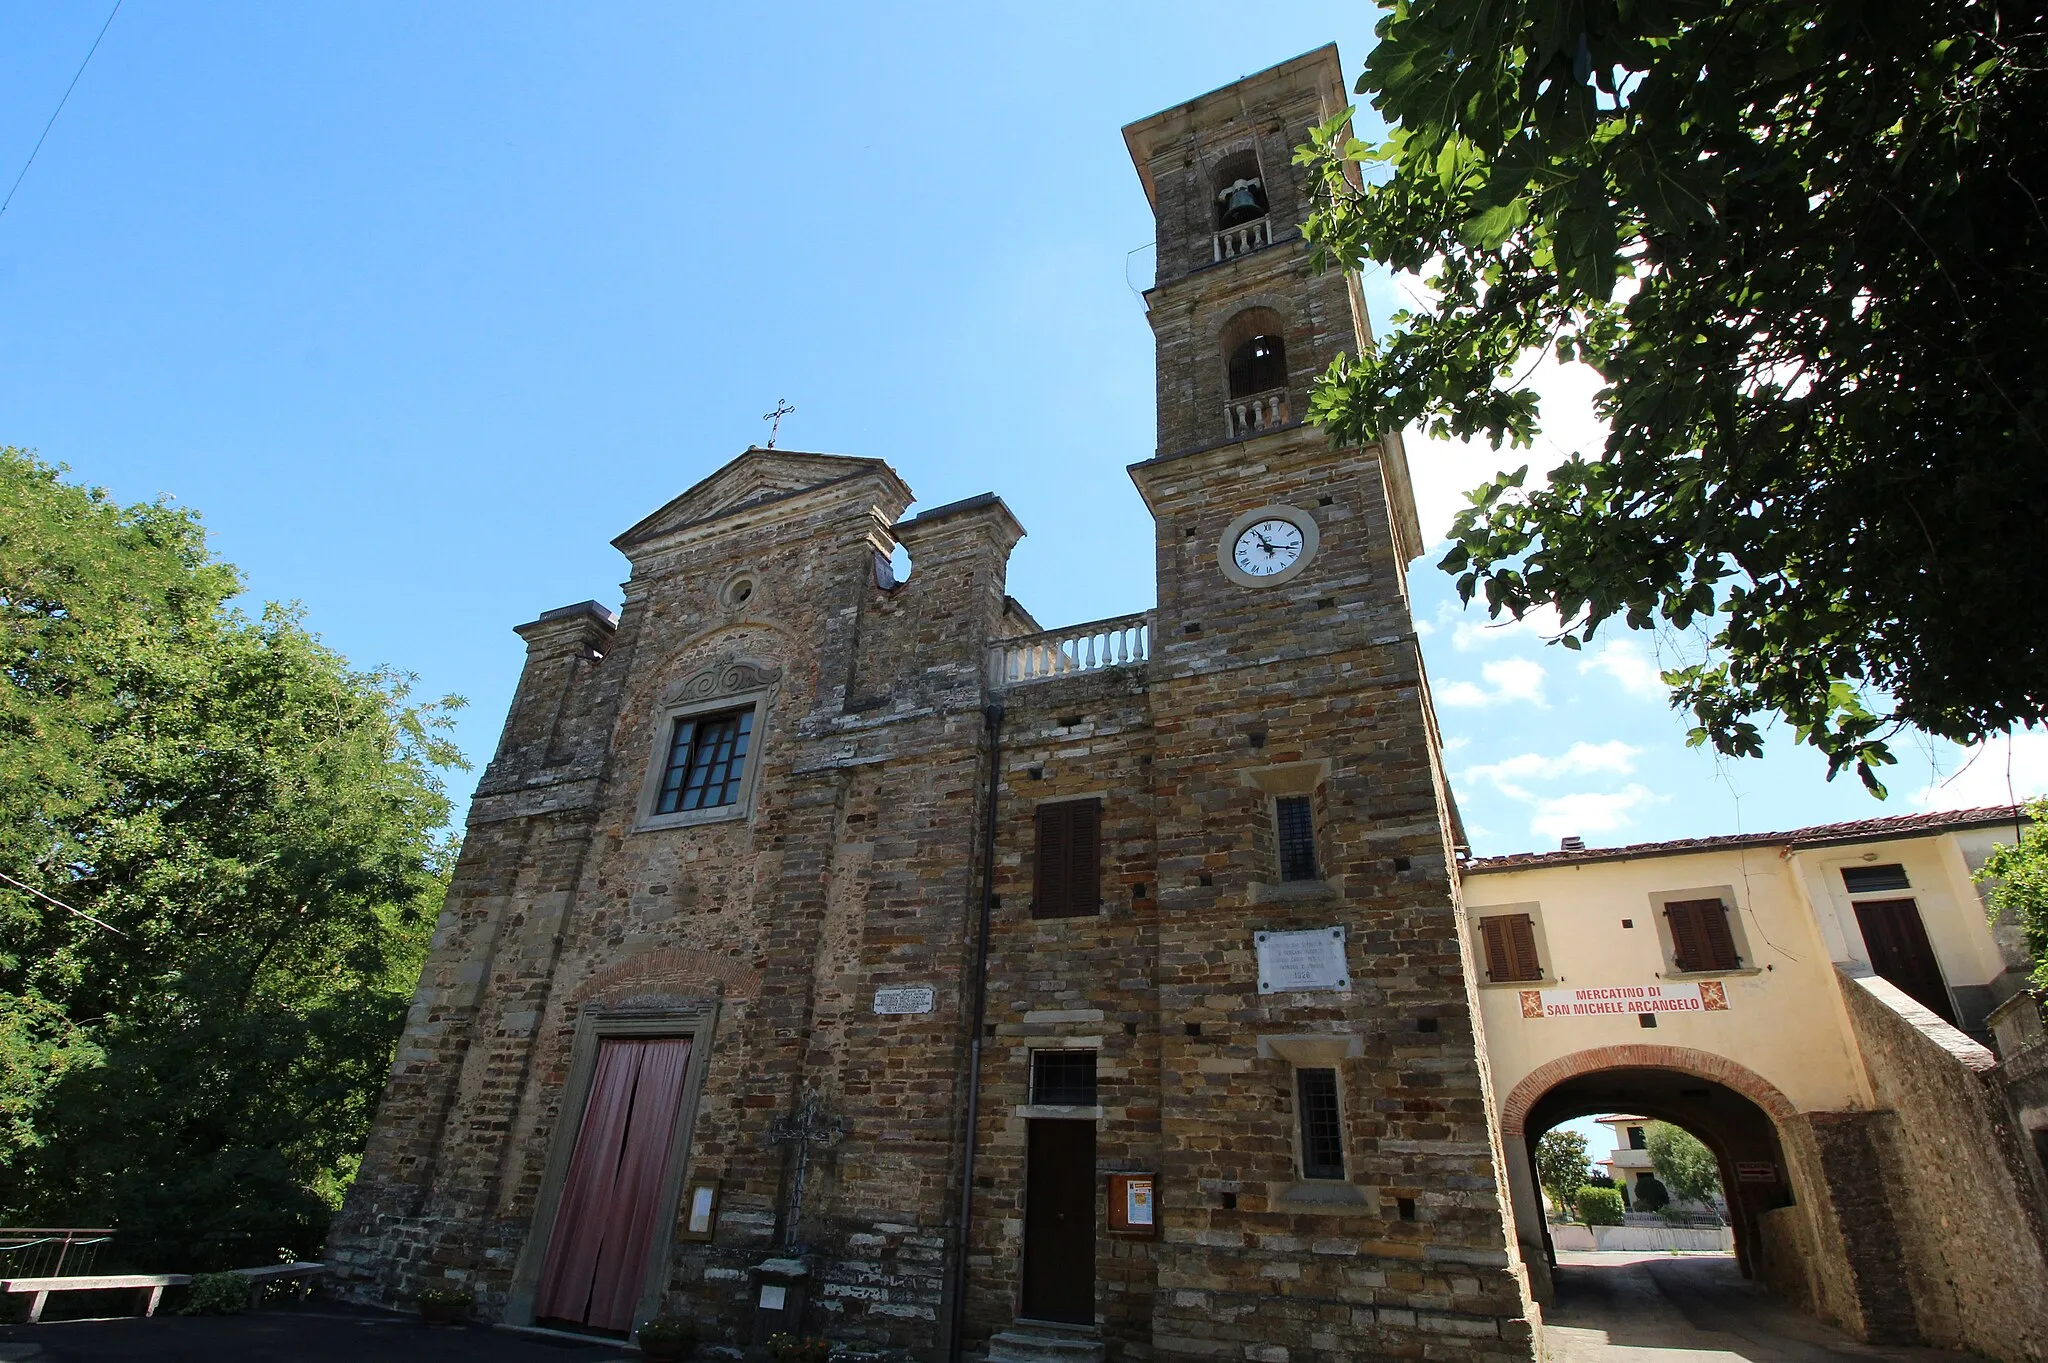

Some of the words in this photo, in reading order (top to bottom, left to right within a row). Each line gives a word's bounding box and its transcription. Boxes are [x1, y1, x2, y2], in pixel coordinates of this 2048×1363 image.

[1576, 986, 1645, 1001] MERCATINO
[1648, 986, 1661, 997] DI
[1546, 1003, 1571, 1016] SAN
[1573, 1001, 1624, 1015] MICHELE
[1627, 998, 1700, 1013] ARCANGELO
